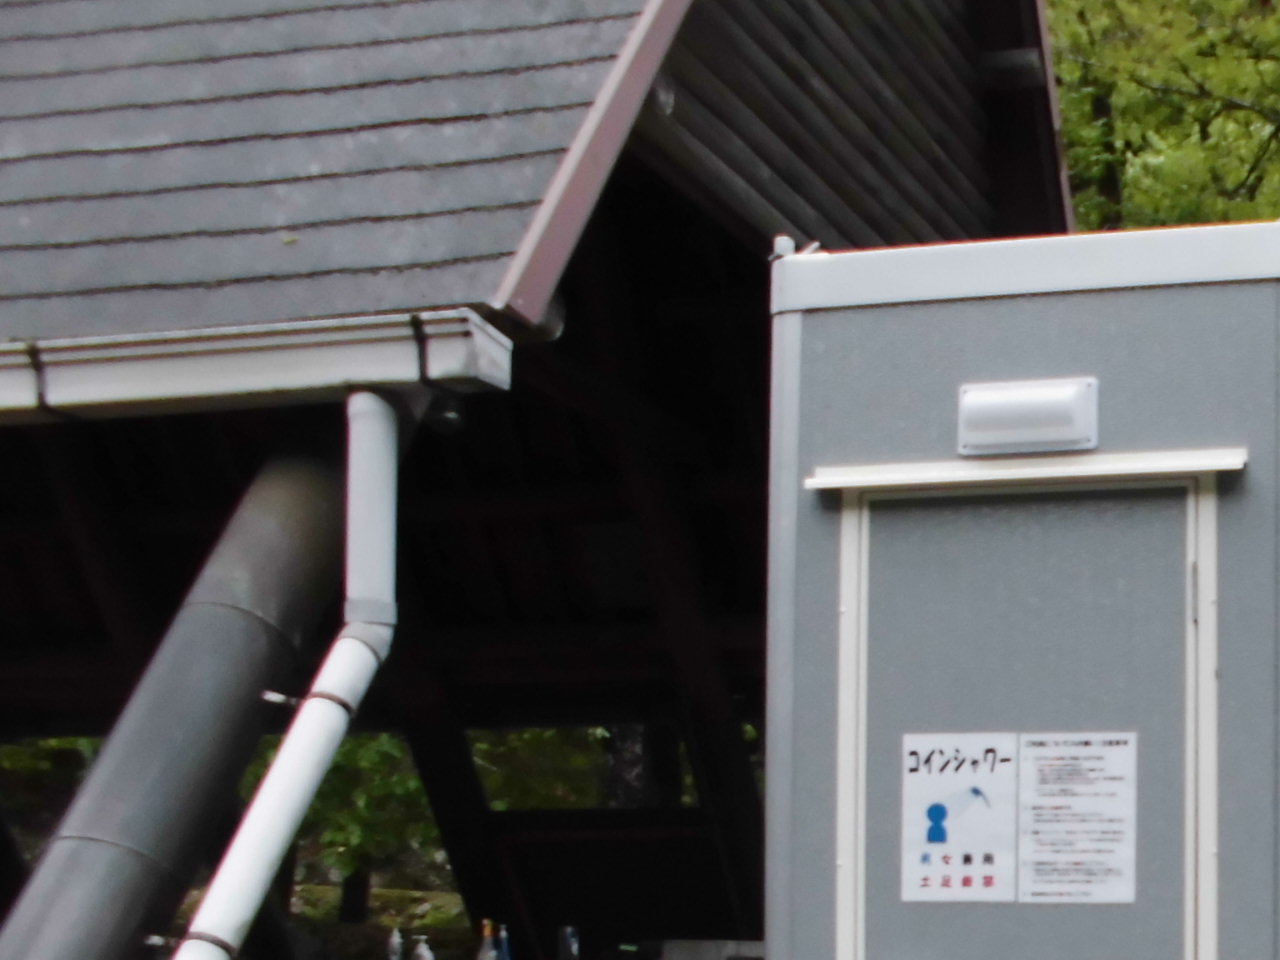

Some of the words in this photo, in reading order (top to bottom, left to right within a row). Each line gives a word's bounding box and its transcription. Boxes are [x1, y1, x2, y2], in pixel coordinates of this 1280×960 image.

[908, 747, 1012, 774] コインシャワー
